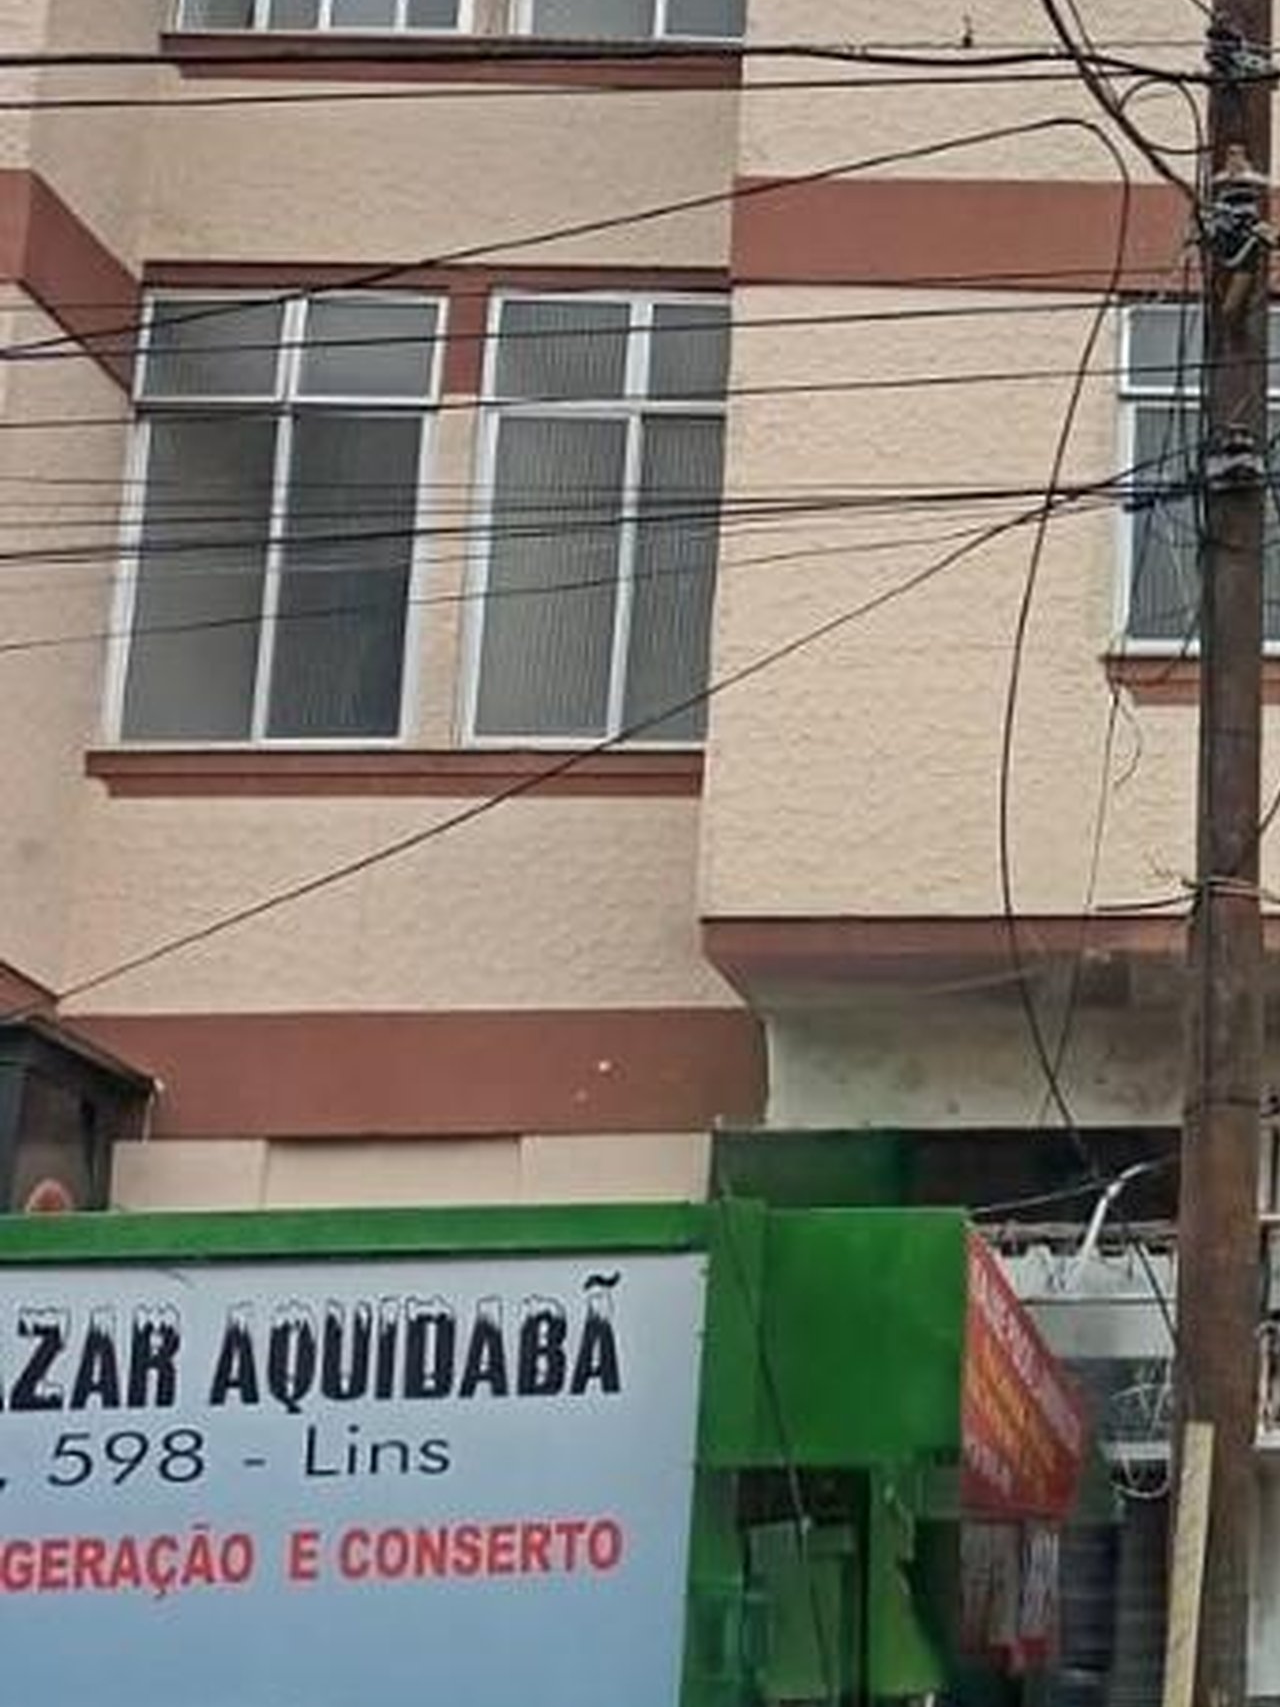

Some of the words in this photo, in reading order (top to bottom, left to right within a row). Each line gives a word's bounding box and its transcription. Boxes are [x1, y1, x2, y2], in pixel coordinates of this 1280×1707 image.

[0, 1305, 181, 1412] ZAR
[209, 1272, 622, 1414] AQUIDABÃ
[48, 1429, 205, 1486] 598
[304, 1424, 452, 1478] Lins
[0, 1524, 254, 1598] GERAÇÃO
[289, 1530, 321, 1581] E
[340, 1520, 623, 1579] CONSERTO
